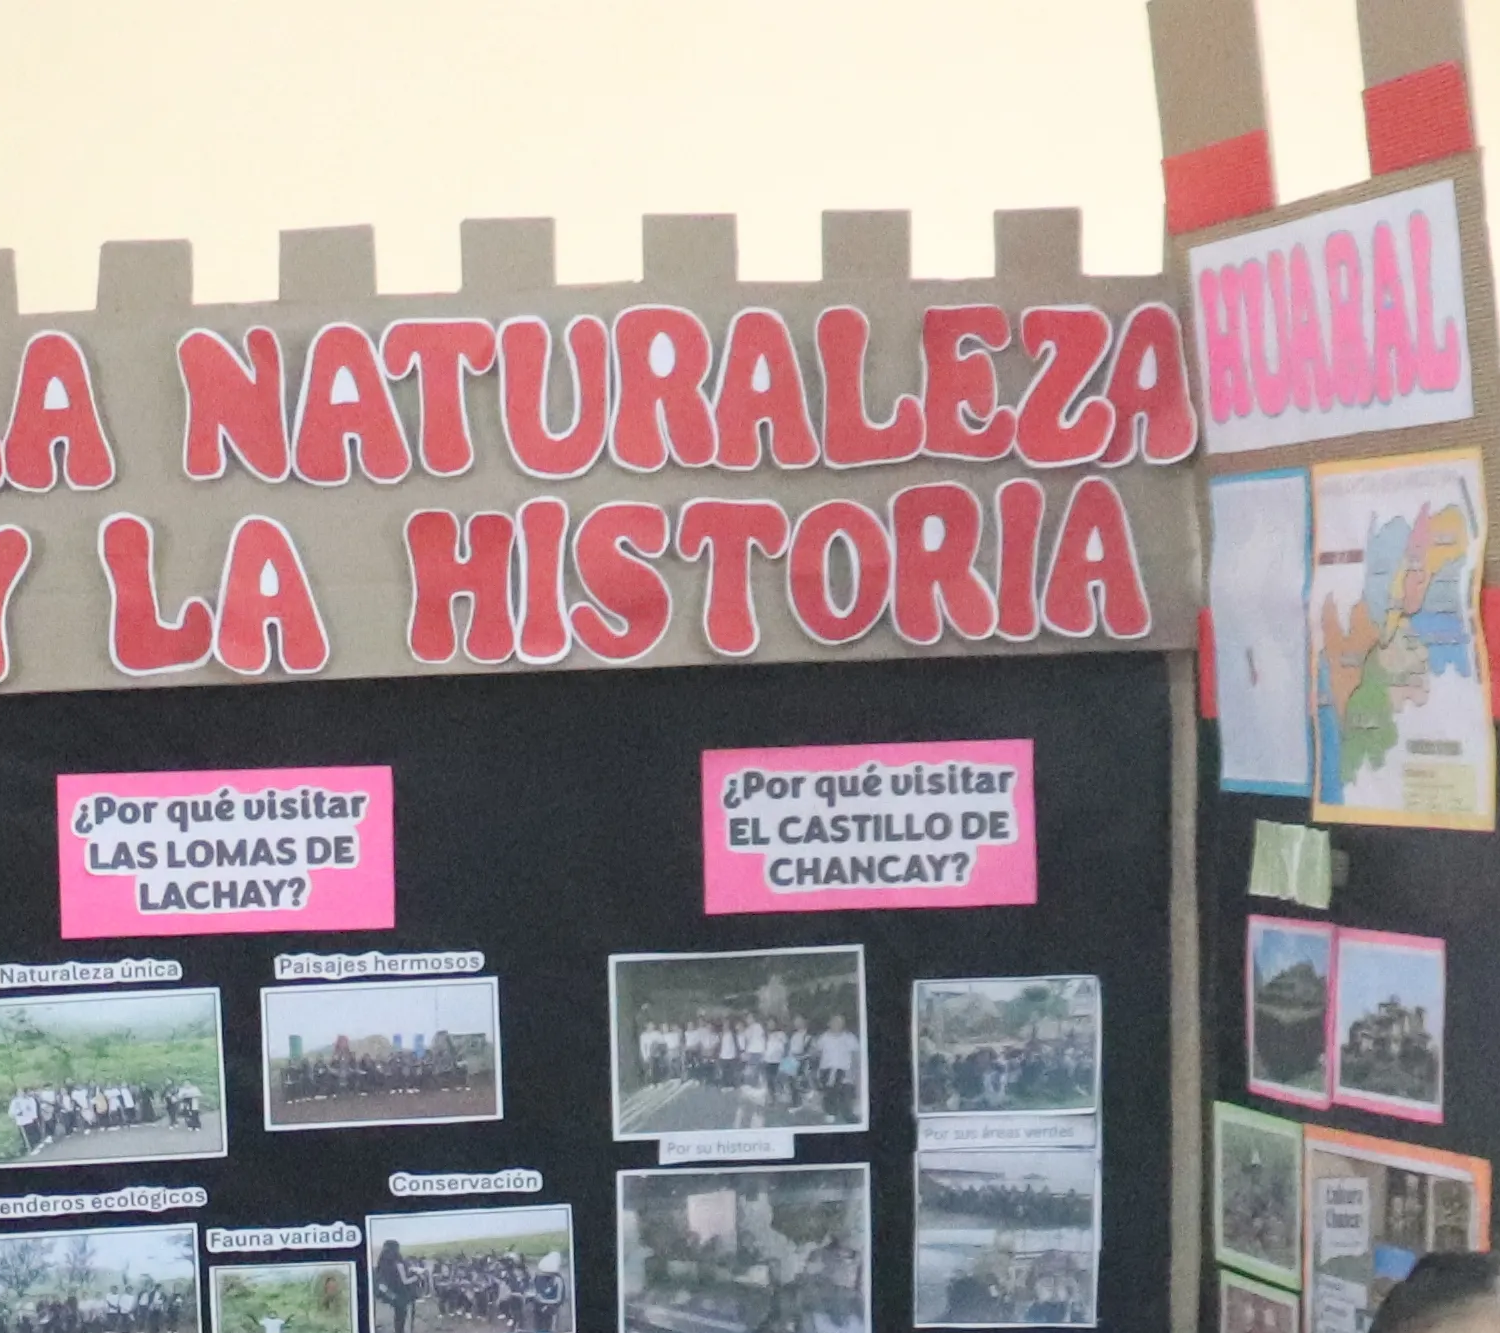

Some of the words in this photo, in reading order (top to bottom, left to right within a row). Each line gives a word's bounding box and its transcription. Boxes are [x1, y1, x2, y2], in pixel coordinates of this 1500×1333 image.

[1200, 209, 1461, 424] HUARAL
[177, 302, 1197, 486] NATURALEZA
[98, 513, 329, 675] LA
[403, 476, 1151, 664] HISTORIA
[724, 771, 806, 809] ¿Por
[815, 764, 883, 807] qué
[891, 764, 1015, 795] visitar
[74, 796, 158, 834] ¿Por
[167, 788, 234, 832] qué
[244, 790, 366, 820] visitar
[729, 817, 770, 845] EL
[778, 812, 952, 844] CASTILLO
[961, 811, 1009, 840] DE
[90, 841, 158, 869] LAS
[167, 838, 297, 868] LOMAS
[307, 836, 355, 864] DE
[769, 852, 970, 886] CHANCAY?
[140, 877, 306, 910] LACHAY?
[0, 964, 114, 985] Naturaleza
[120, 957, 179, 980] única
[279, 956, 368, 977] Paisajes
[374, 953, 480, 974] hermosos
[667, 1141, 691, 1156] Por
[696, 1144, 712, 1155] su
[392, 1169, 539, 1193] Conservación
[91, 1187, 206, 1211] ecológicos
[211, 1229, 274, 1249] Fauna
[280, 1225, 358, 1246] variada
